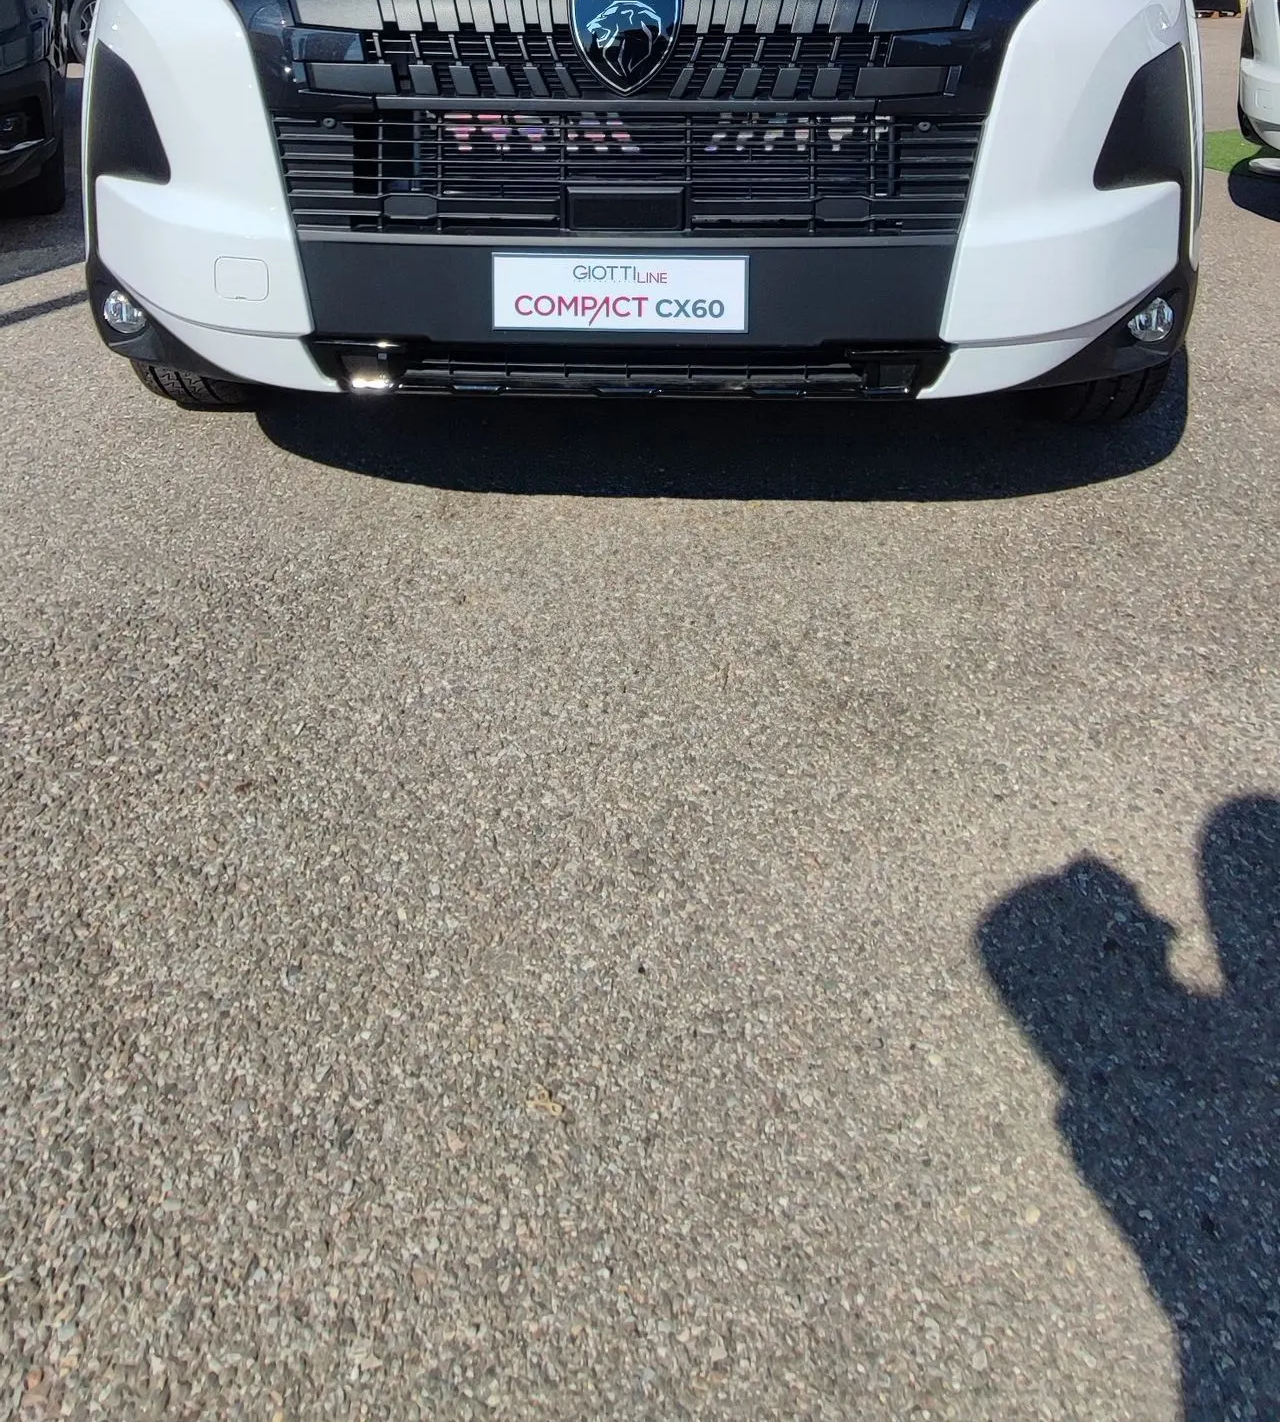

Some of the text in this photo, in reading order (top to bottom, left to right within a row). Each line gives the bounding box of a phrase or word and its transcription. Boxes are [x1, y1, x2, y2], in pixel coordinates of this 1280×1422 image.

[572, 264, 668, 284] GIOTTILINE
[514, 295, 725, 326] COMPACT CX60
